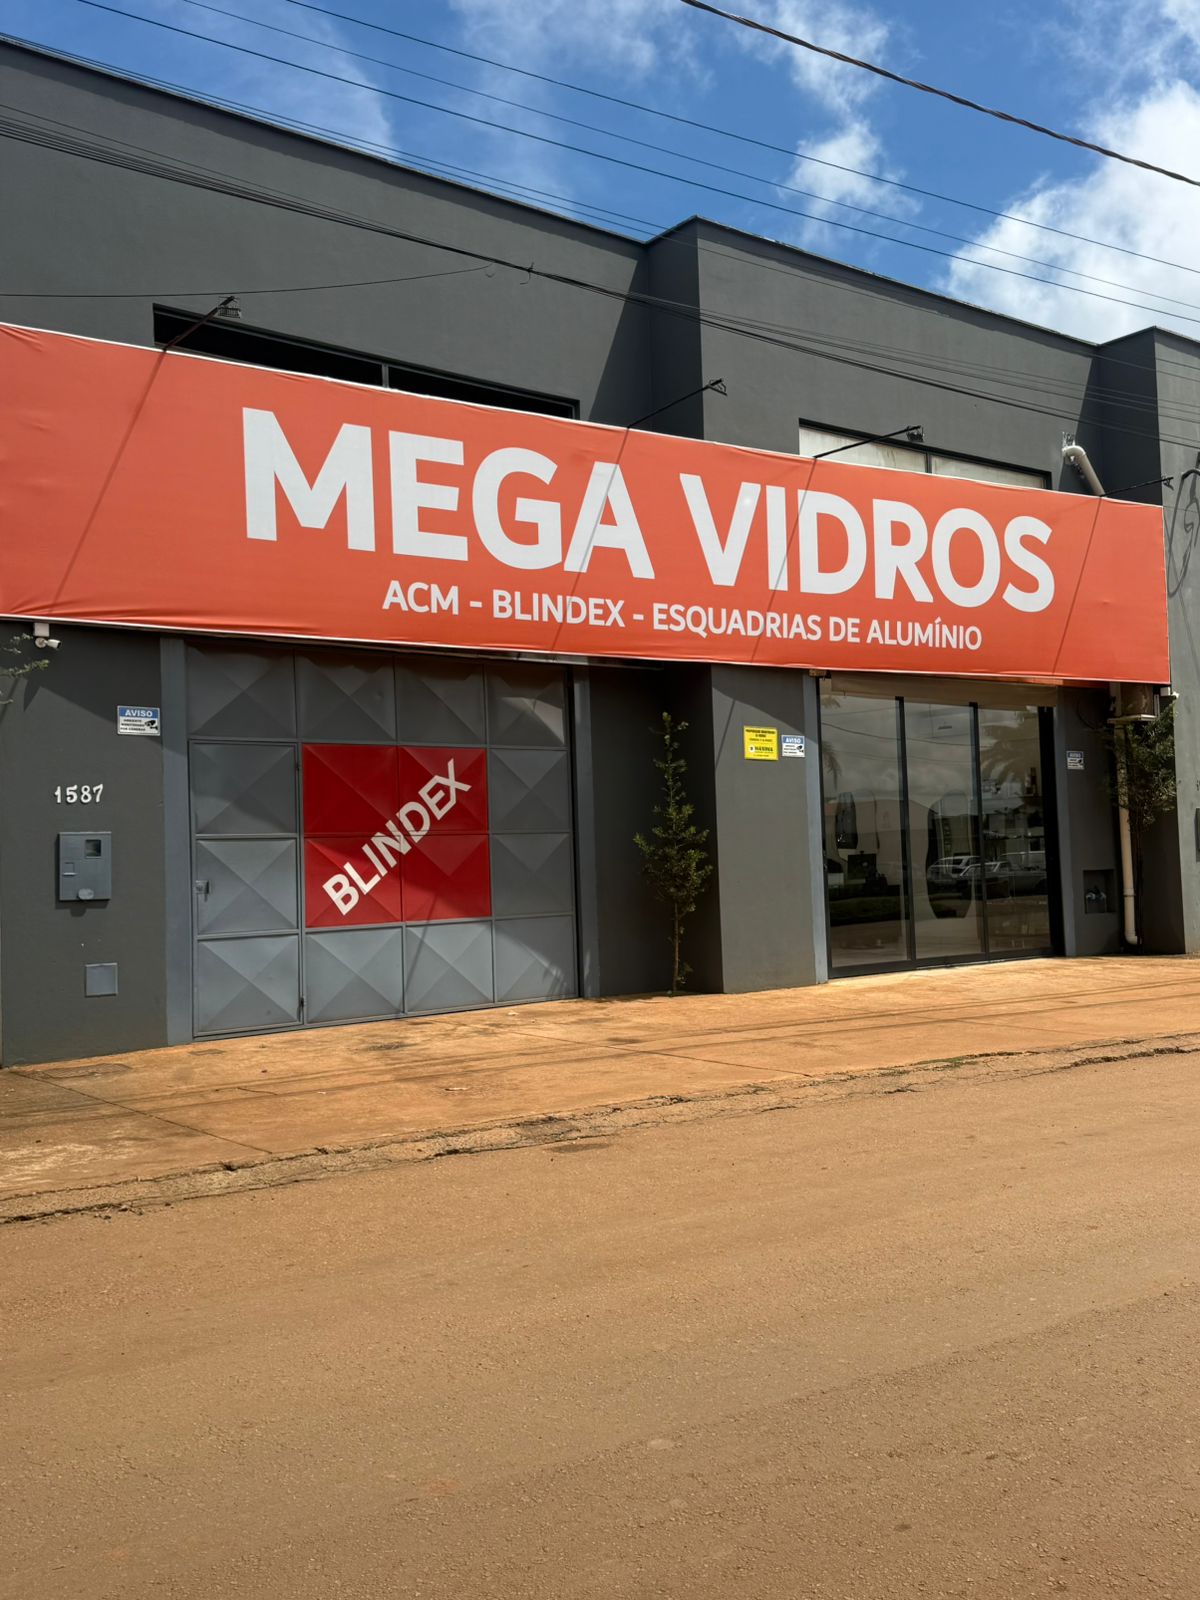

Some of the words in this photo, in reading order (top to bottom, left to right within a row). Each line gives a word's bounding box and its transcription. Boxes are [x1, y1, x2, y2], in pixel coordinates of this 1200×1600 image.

[242, 407, 656, 581] MEGA
[680, 473, 1055, 613] VIDROS
[382, 580, 459, 615] ACM
[492, 588, 625, 628] BLINDEX
[652, 602, 822, 642] ESQUADRIAS
[829, 616, 861, 643] DE
[866, 616, 982, 651] ALUMÍNIO
[125, 709, 153, 717] AVISO
[54, 783, 104, 804] 1587
[322, 758, 472, 916] BLINDEX
